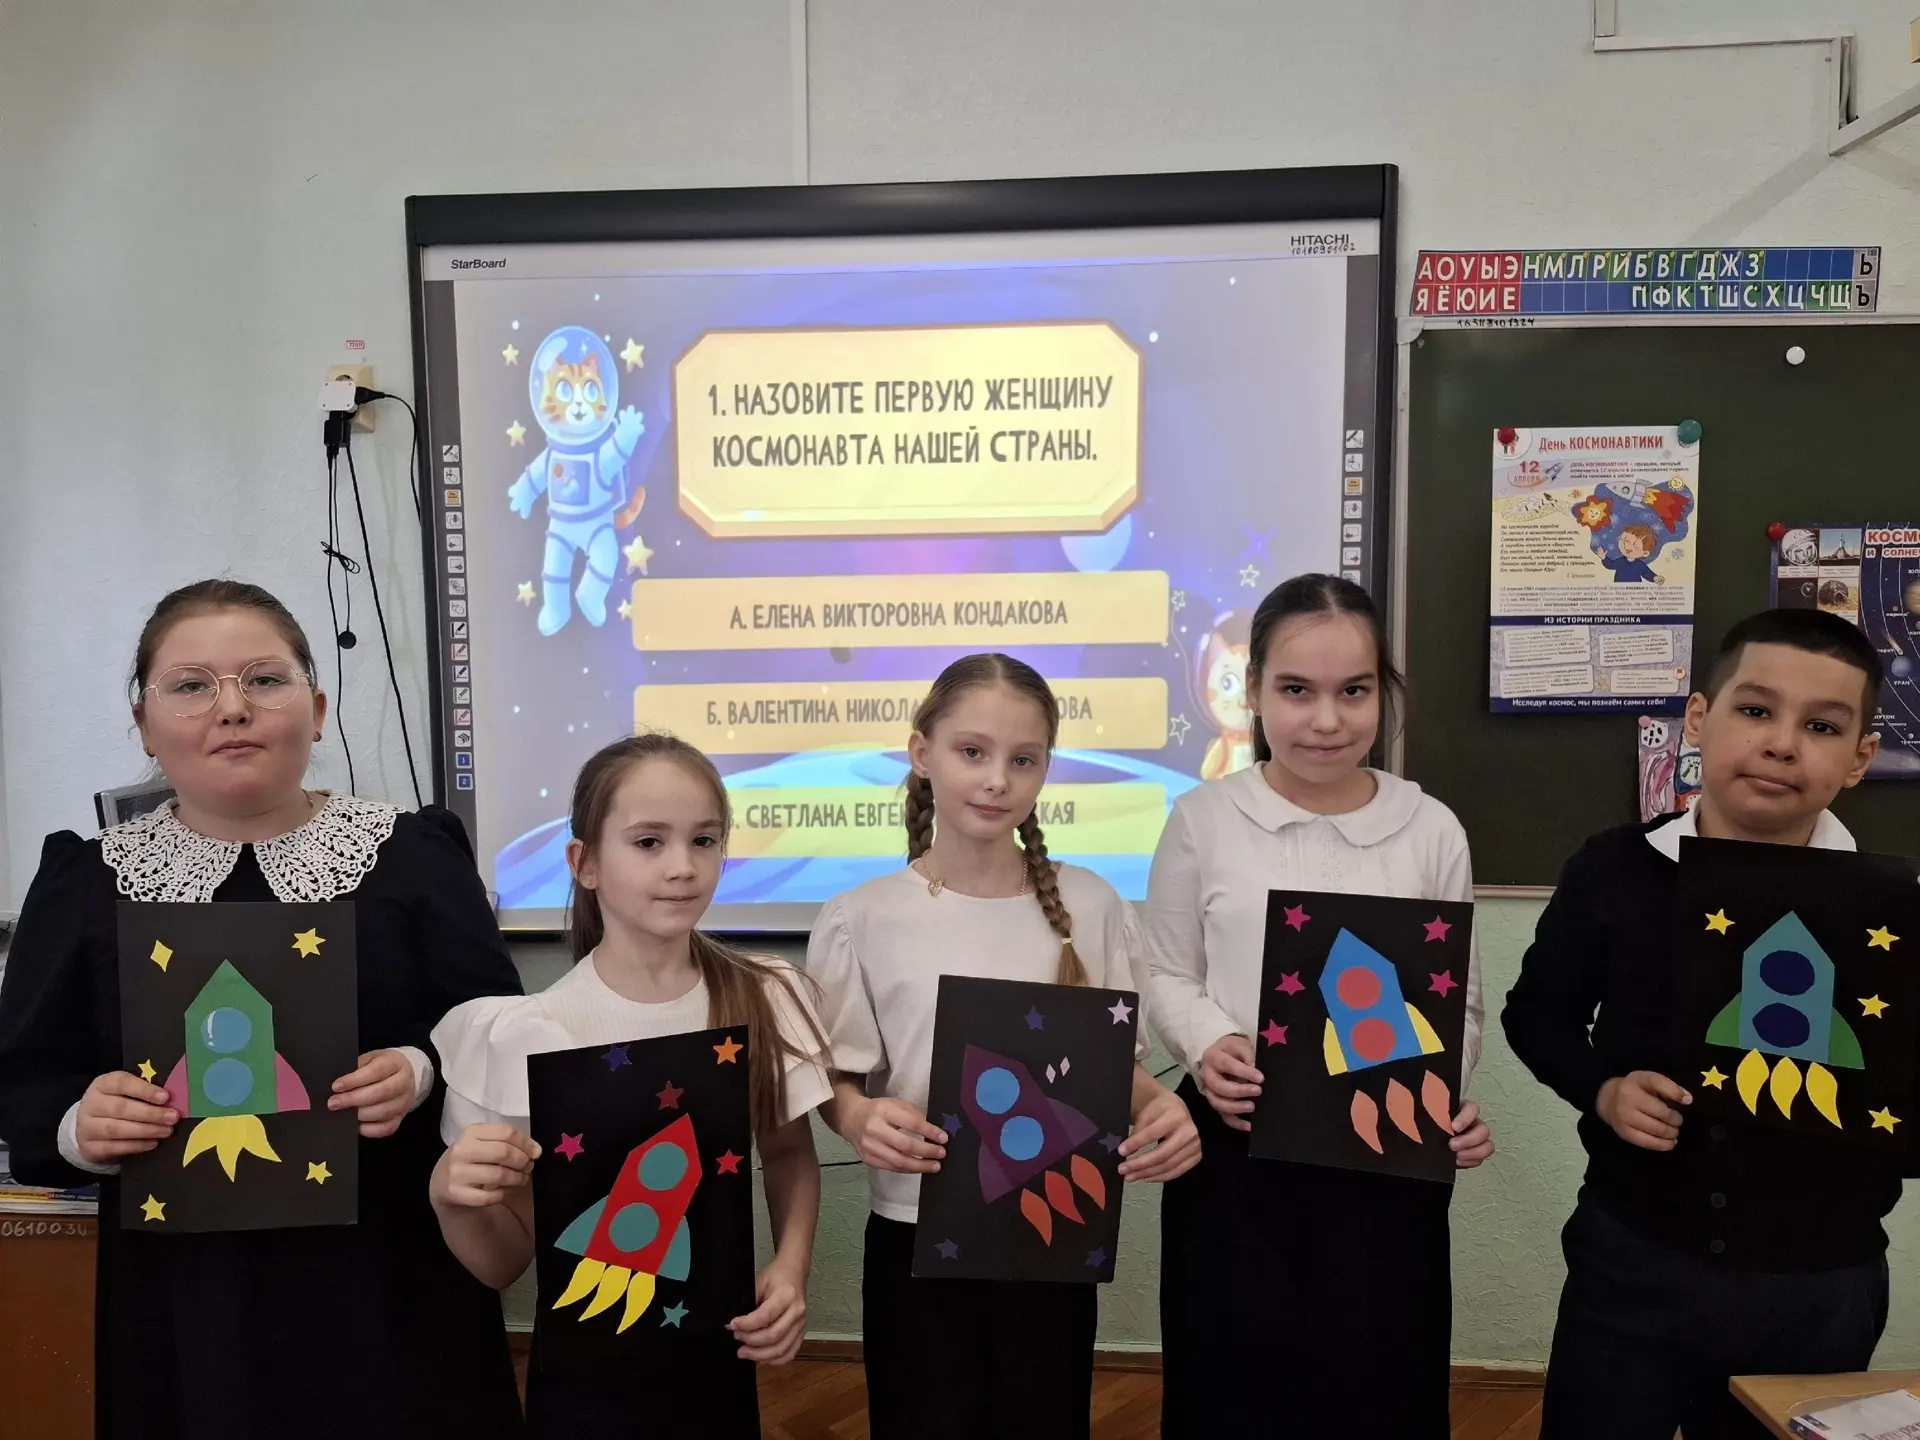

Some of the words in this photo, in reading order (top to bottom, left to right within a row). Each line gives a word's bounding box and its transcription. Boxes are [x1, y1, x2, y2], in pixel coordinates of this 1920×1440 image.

[1290, 234, 1349, 246] HITACHI
[451, 257, 507, 270] StarBoard
[708, 384, 727, 416] 1.
[734, 381, 865, 416] НАЗОВИТЕ
[875, 378, 974, 413] ПЕРВУЮ
[984, 375, 1113, 411] ЖЕНЩИНУ
[713, 433, 884, 468] КОСМОНАВТА
[895, 425, 979, 465] НАШЕЙ
[990, 429, 1097, 463] СТРАНЫ.
[1539, 437, 1566, 452] День
[1569, 435, 1663, 450] КОСМОНАВТИКИ
[1519, 460, 1540, 473] 12
[1868, 530, 1920, 543] КОСМ
[730, 605, 747, 629] А.
[753, 604, 816, 629] ЕЛЕНА
[823, 602, 947, 628] ВИКТОРОВНА
[954, 600, 1068, 627] КОНДАКОВА
[1544, 616, 1555, 624] ИЗ
[1556, 615, 1593, 624] ИСТОРИИ
[1594, 615, 1641, 625] ПРАЗДНИКА
[707, 701, 722, 726] Б.
[728, 699, 839, 725] ВАЛЕНТИНА
[846, 698, 922, 723] НИКОЛА
[1057, 696, 1092, 720] ОВА
[746, 803, 847, 829] СВЕТЛАНА
[855, 803, 906, 828] ЕВГЕН
[1040, 801, 1074, 824] КАЯ
